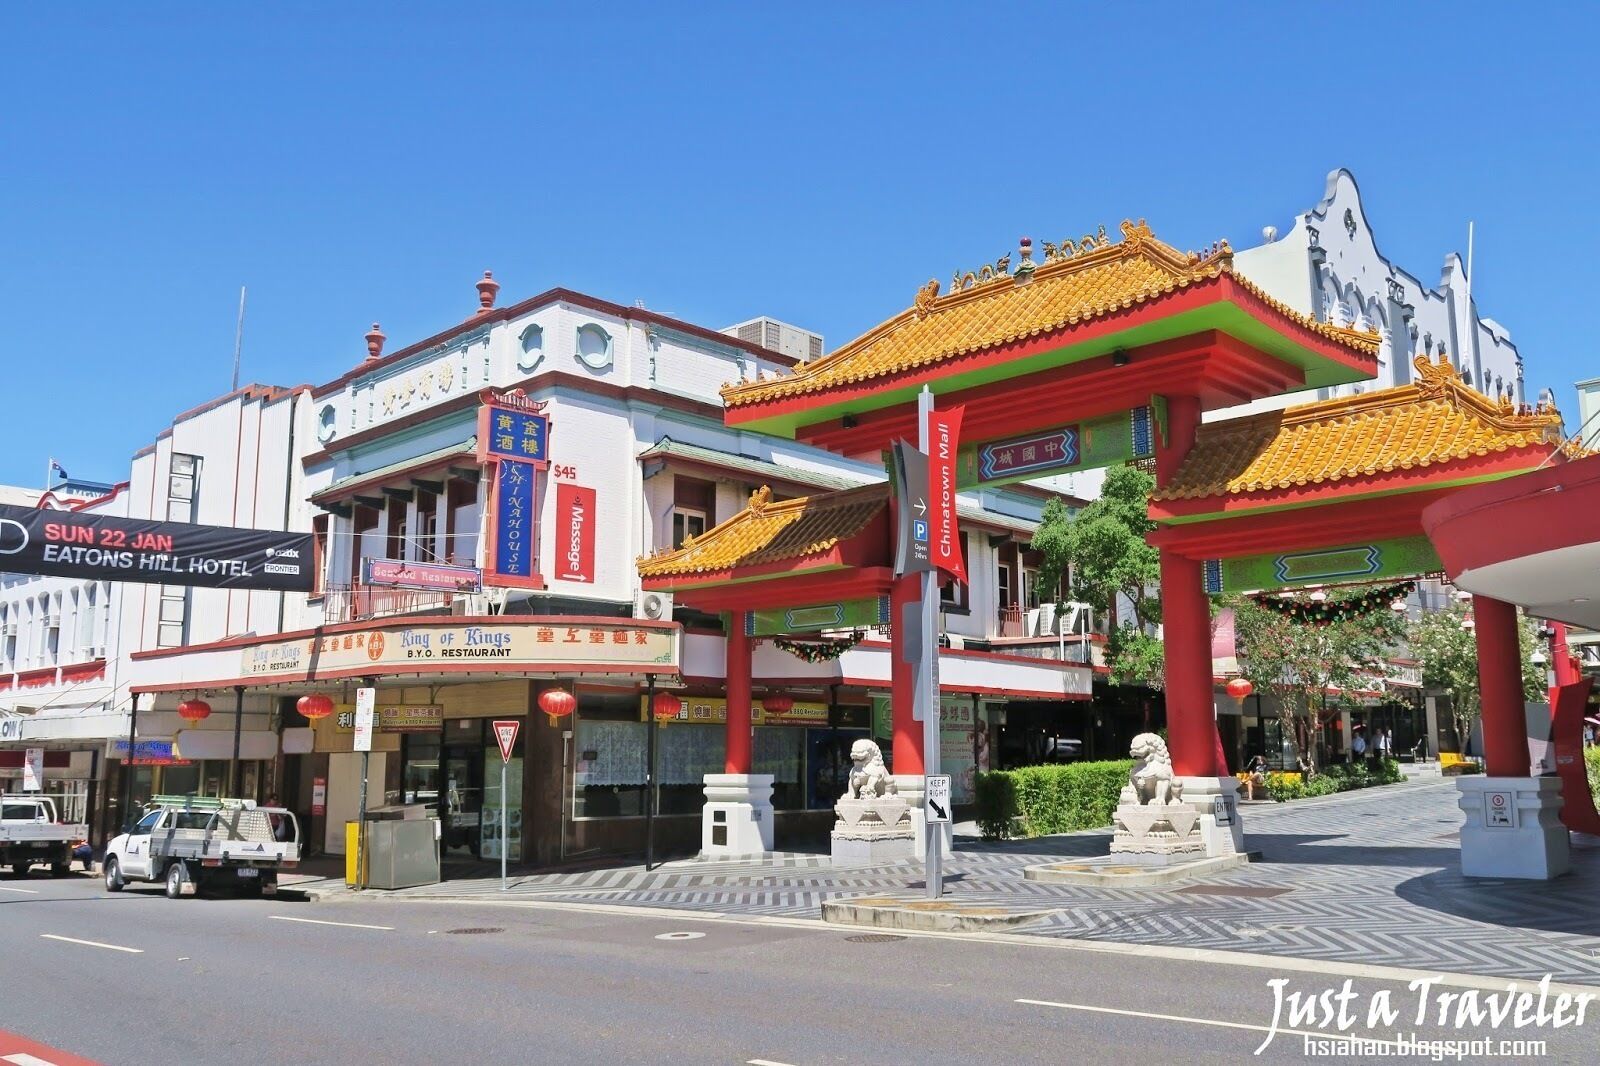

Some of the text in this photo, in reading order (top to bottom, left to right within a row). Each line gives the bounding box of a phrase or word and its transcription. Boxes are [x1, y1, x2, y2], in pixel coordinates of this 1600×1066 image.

[999, 441, 1058, 466] 中國城
[554, 464, 576, 480] $45
[938, 423, 951, 557] Chinatown Mall
[44, 523, 172, 552] SUN 22 JAN
[567, 506, 585, 571] Massage
[43, 544, 253, 577] EATONS HILL HOTEL
[265, 564, 299, 573] FRONTIER
[401, 626, 511, 649] King of Kings
[441, 648, 511, 657] RESTAURANT
[270, 661, 300, 671] RESTAURANT
[929, 789, 946, 797] RIGHT
[1216, 801, 1232, 812] ENTRY
